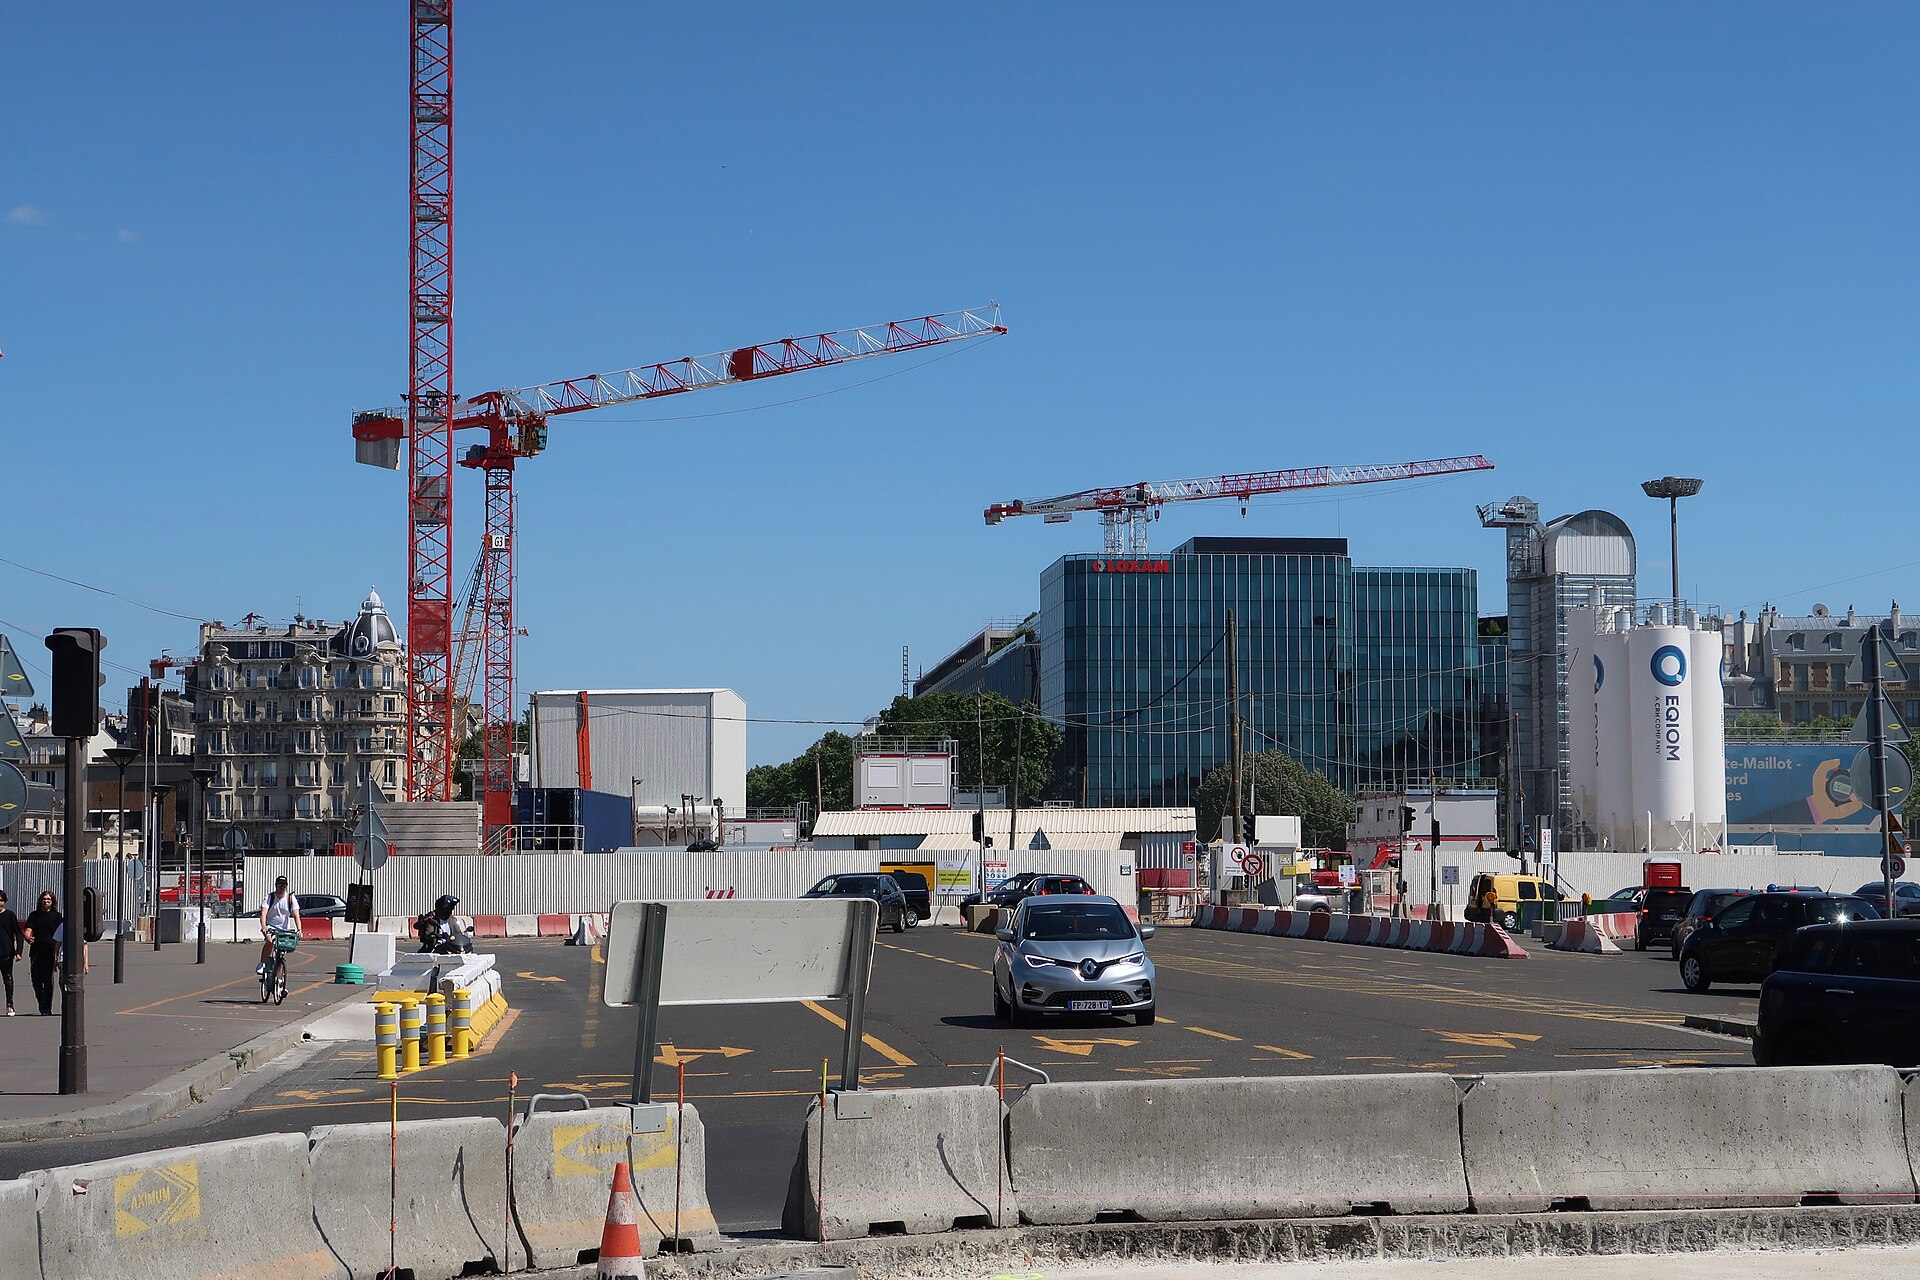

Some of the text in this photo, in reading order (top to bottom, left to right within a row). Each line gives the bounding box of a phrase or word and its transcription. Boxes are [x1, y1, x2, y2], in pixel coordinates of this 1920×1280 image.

[494, 536, 503, 547] G3
[1108, 560, 1169, 573] LOXAM
[1665, 695, 1681, 761] EQIOM
[131, 1186, 171, 1210] AXIMUM
